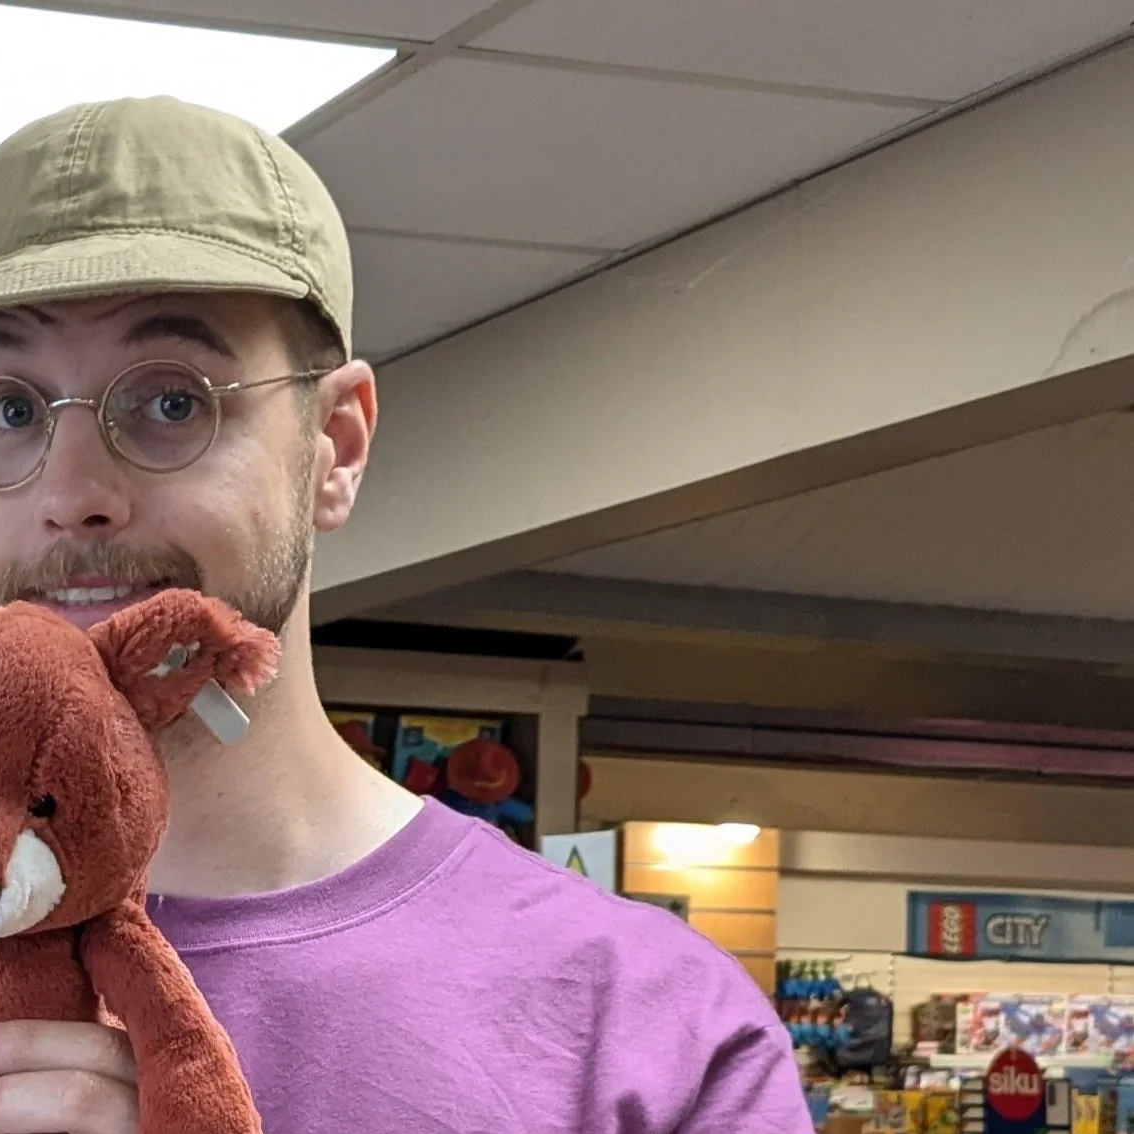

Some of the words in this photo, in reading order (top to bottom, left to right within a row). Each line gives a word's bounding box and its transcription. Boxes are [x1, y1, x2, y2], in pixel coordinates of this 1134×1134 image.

[941, 904, 962, 954] LEGO
[985, 914, 1049, 946] CITY
[988, 1066, 1040, 1095] siku
